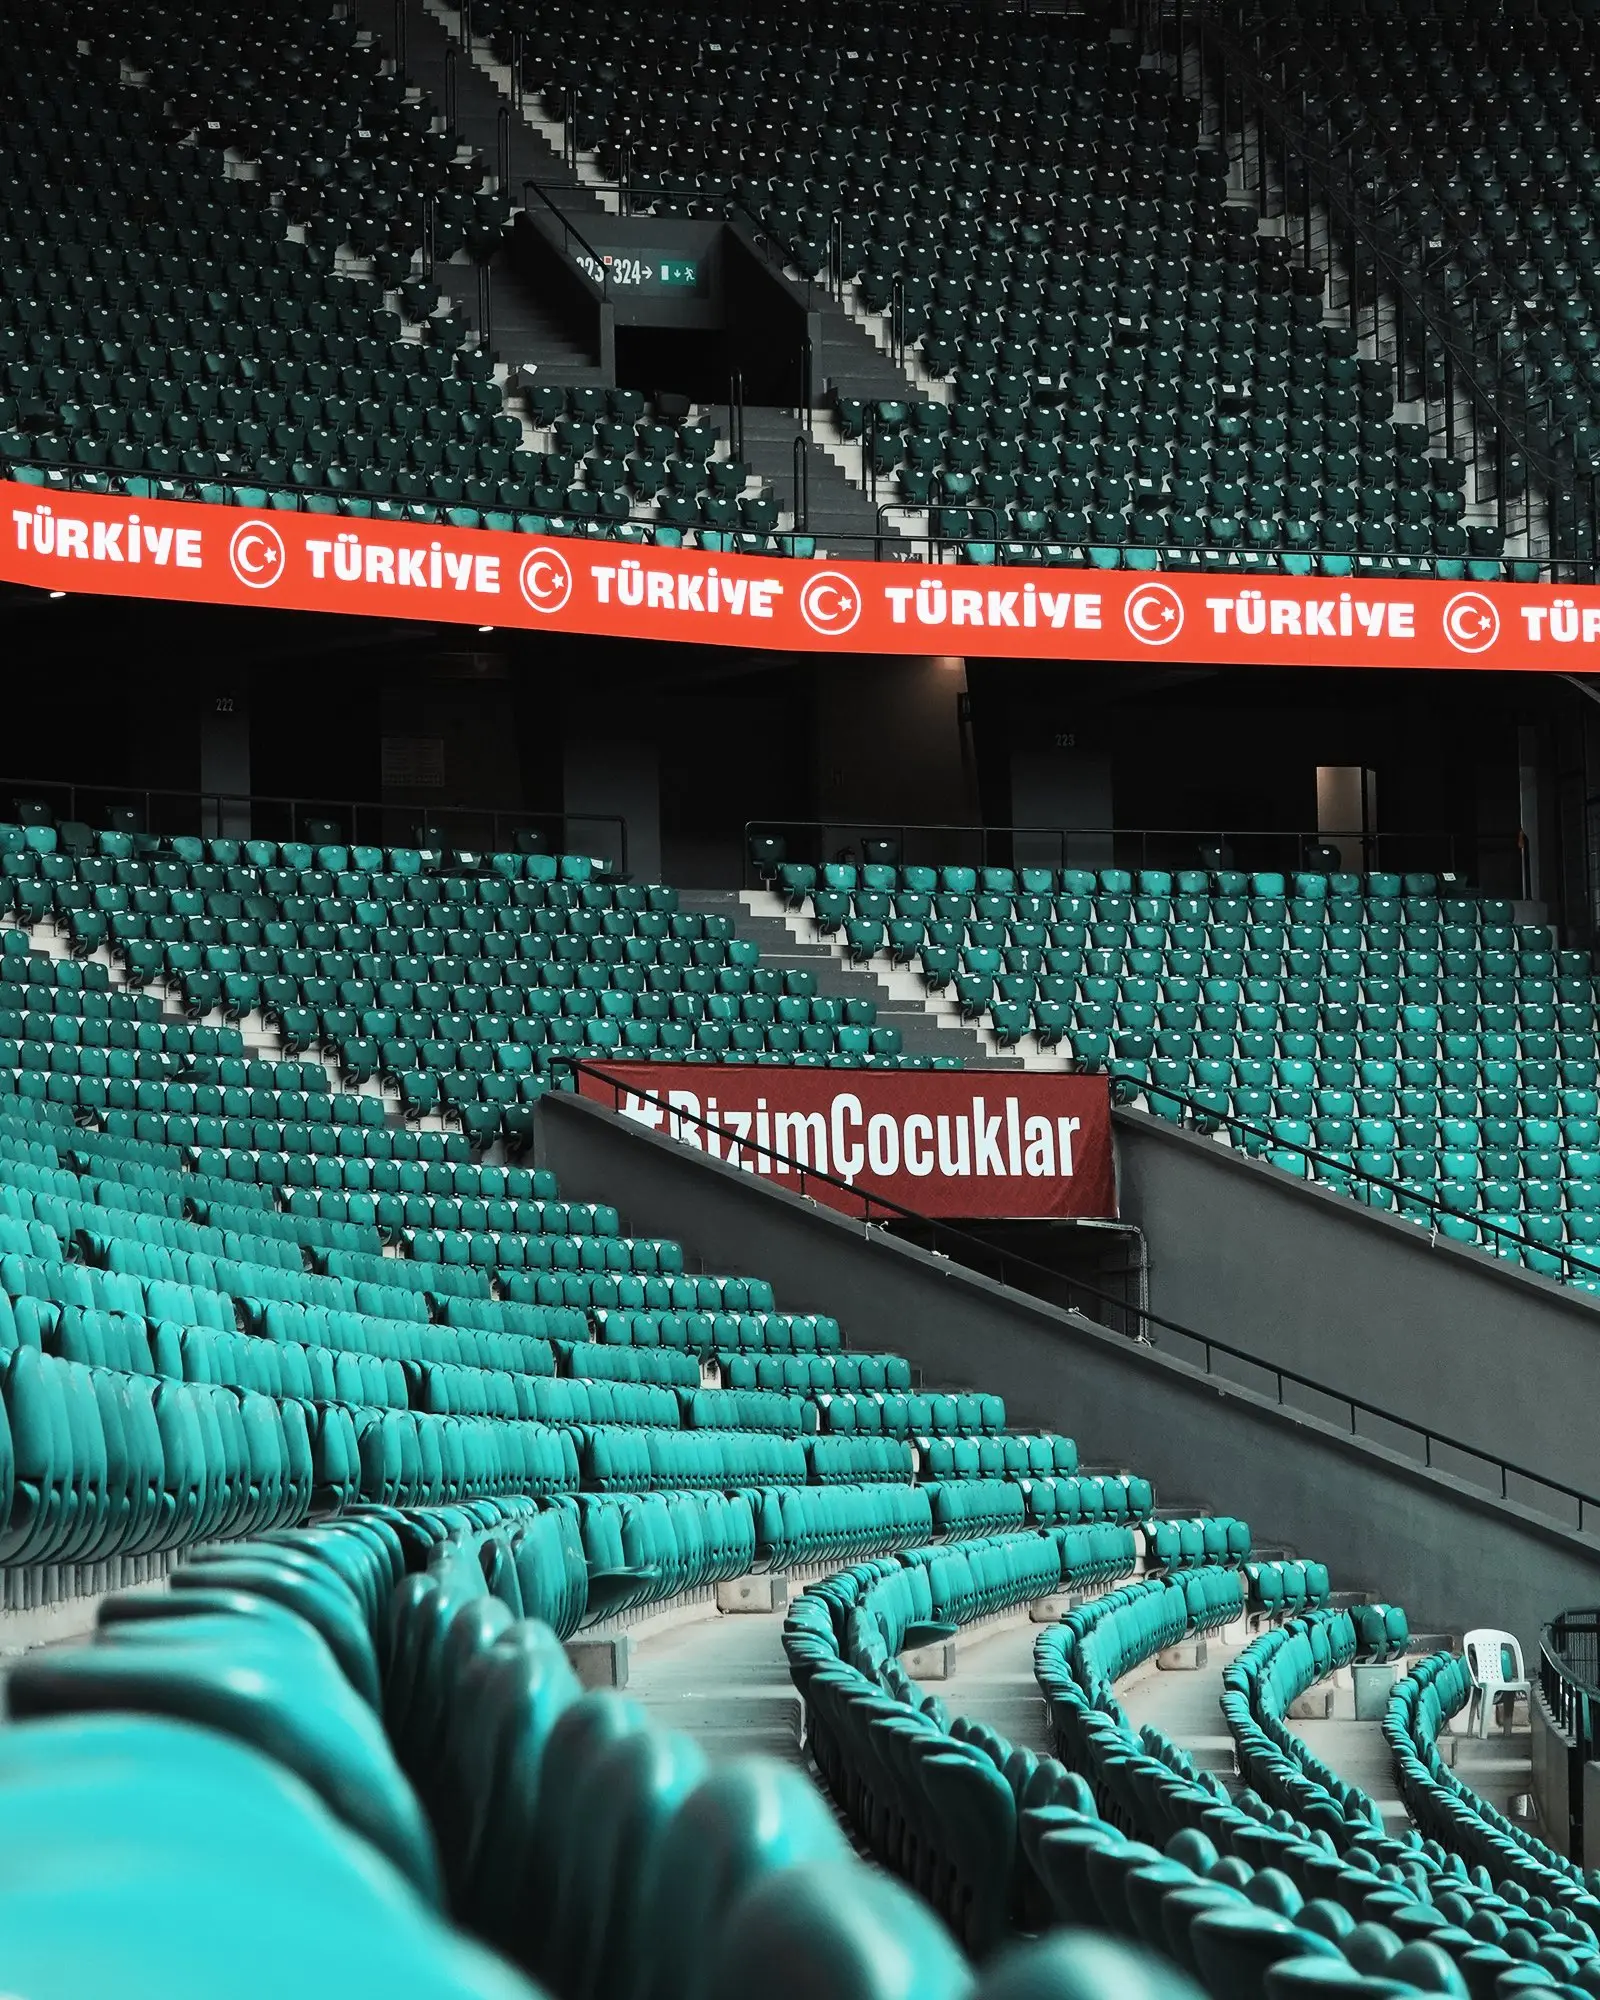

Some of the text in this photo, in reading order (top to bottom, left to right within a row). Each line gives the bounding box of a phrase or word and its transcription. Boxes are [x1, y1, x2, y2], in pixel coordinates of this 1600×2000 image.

[613, 258, 641, 285] 324
[12, 504, 202, 569] TÜRKİYE
[305, 532, 501, 595] TÜRKİYE
[590, 559, 784, 619] TÜRKİYE
[884, 579, 1103, 631] TÜRKİYE
[1205, 589, 1416, 640] TÜRKİYE
